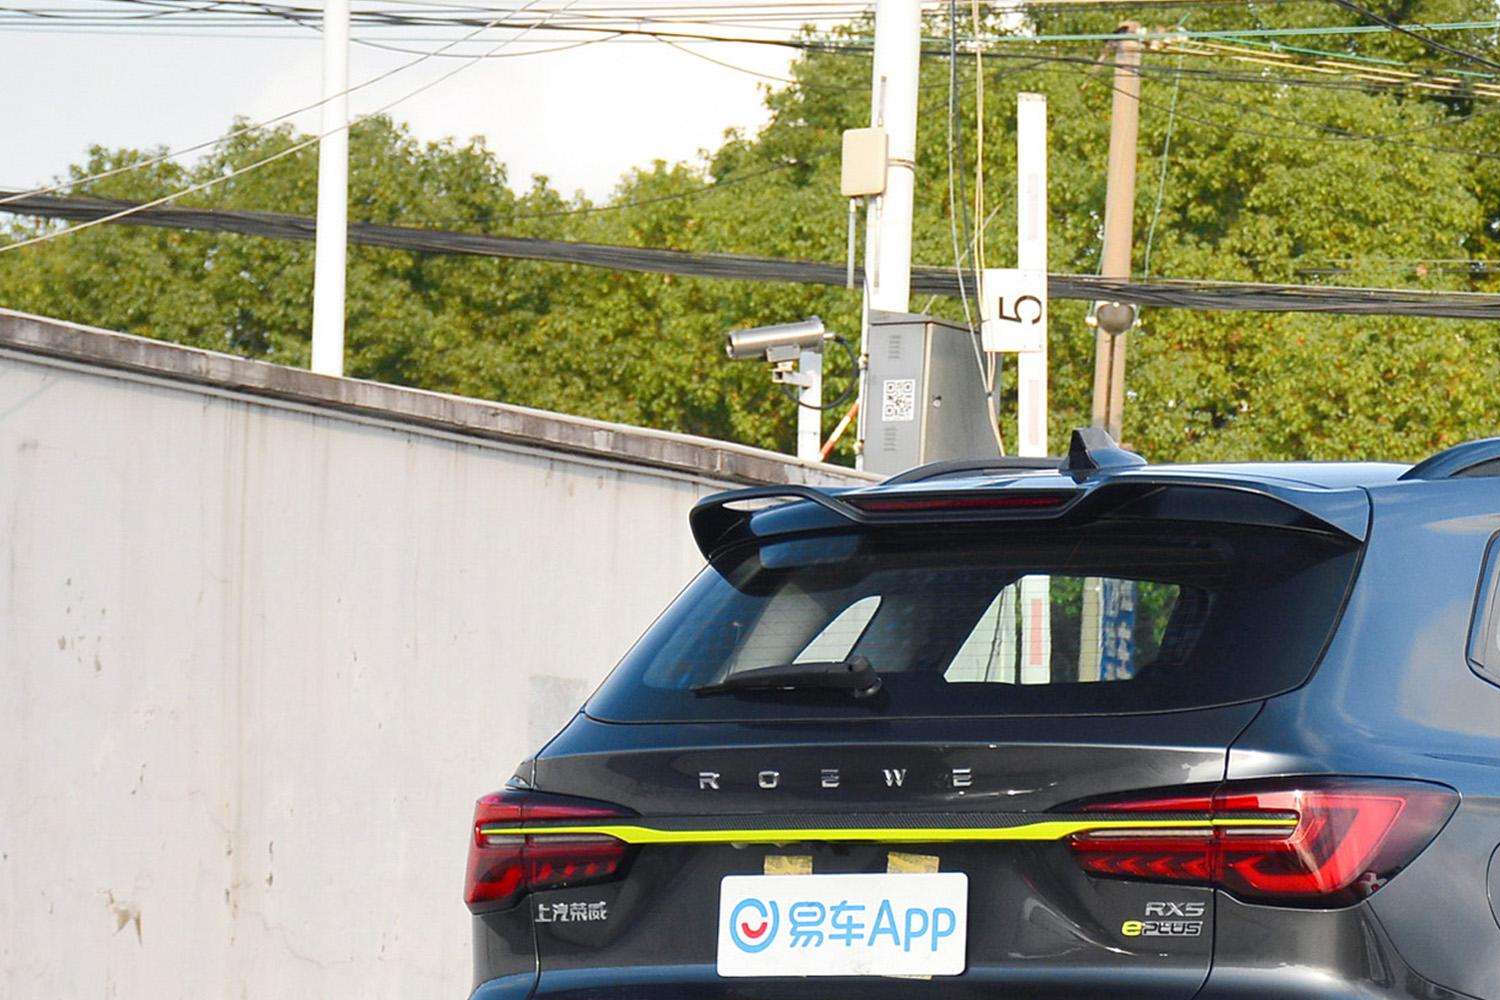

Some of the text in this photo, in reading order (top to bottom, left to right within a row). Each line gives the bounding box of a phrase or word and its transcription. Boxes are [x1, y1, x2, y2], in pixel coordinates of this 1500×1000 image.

[999, 295, 1042, 325] 5
[699, 768, 972, 790] ROEWE
[535, 901, 607, 922] 上汽荣威
[1145, 902, 1205, 916] RX5
[788, 899, 956, 952] 易车App
